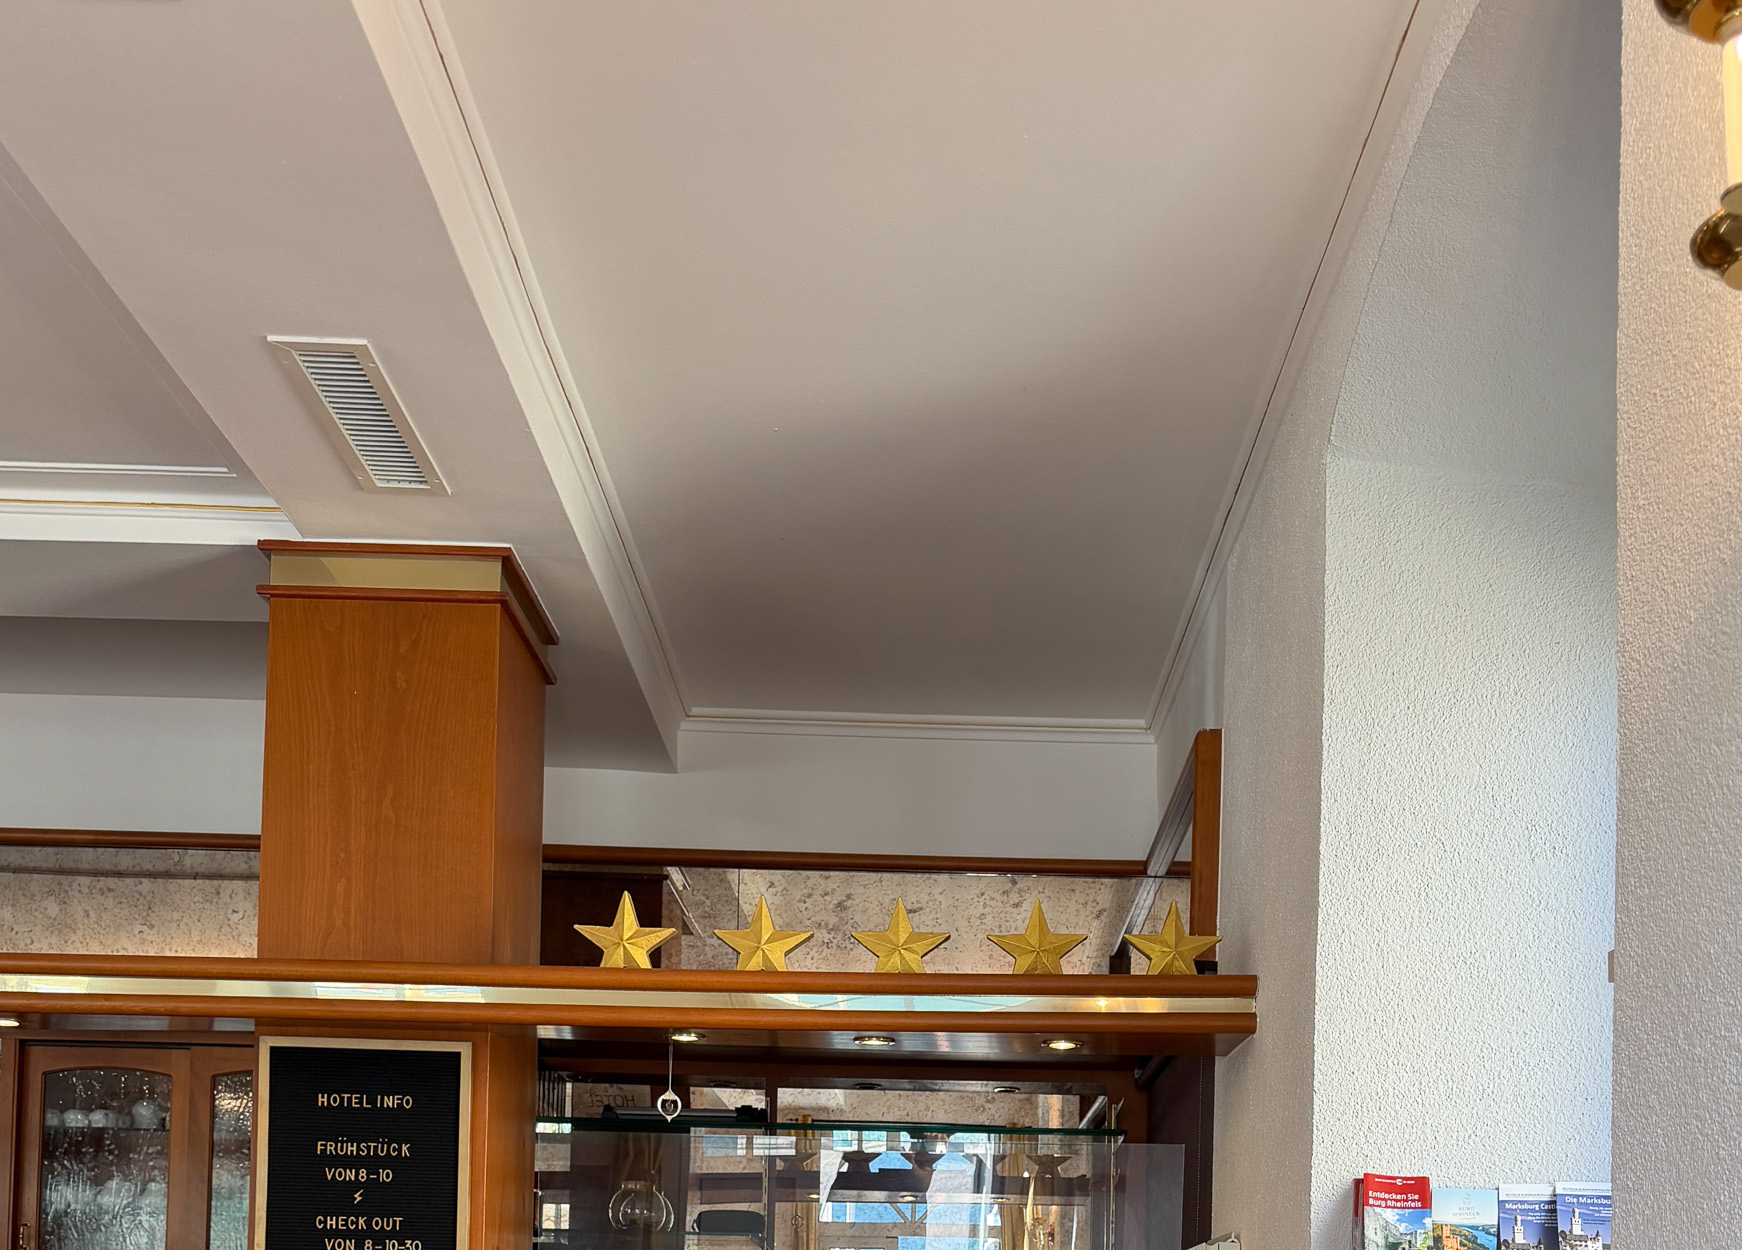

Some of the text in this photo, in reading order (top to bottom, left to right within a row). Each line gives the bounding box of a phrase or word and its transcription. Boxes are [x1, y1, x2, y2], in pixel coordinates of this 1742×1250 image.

[318, 1093, 413, 1109] HOTEL INFO
[317, 1137, 411, 1157] FRÜHSTÜCK
[325, 1167, 393, 1183] VON 8-10
[1368, 1191, 1406, 1200] Entdecken
[1368, 1198, 1422, 1208] Burg Rheinfels
[1565, 1196, 1578, 1204] Die
[315, 1215, 404, 1231] CHECK OUT
